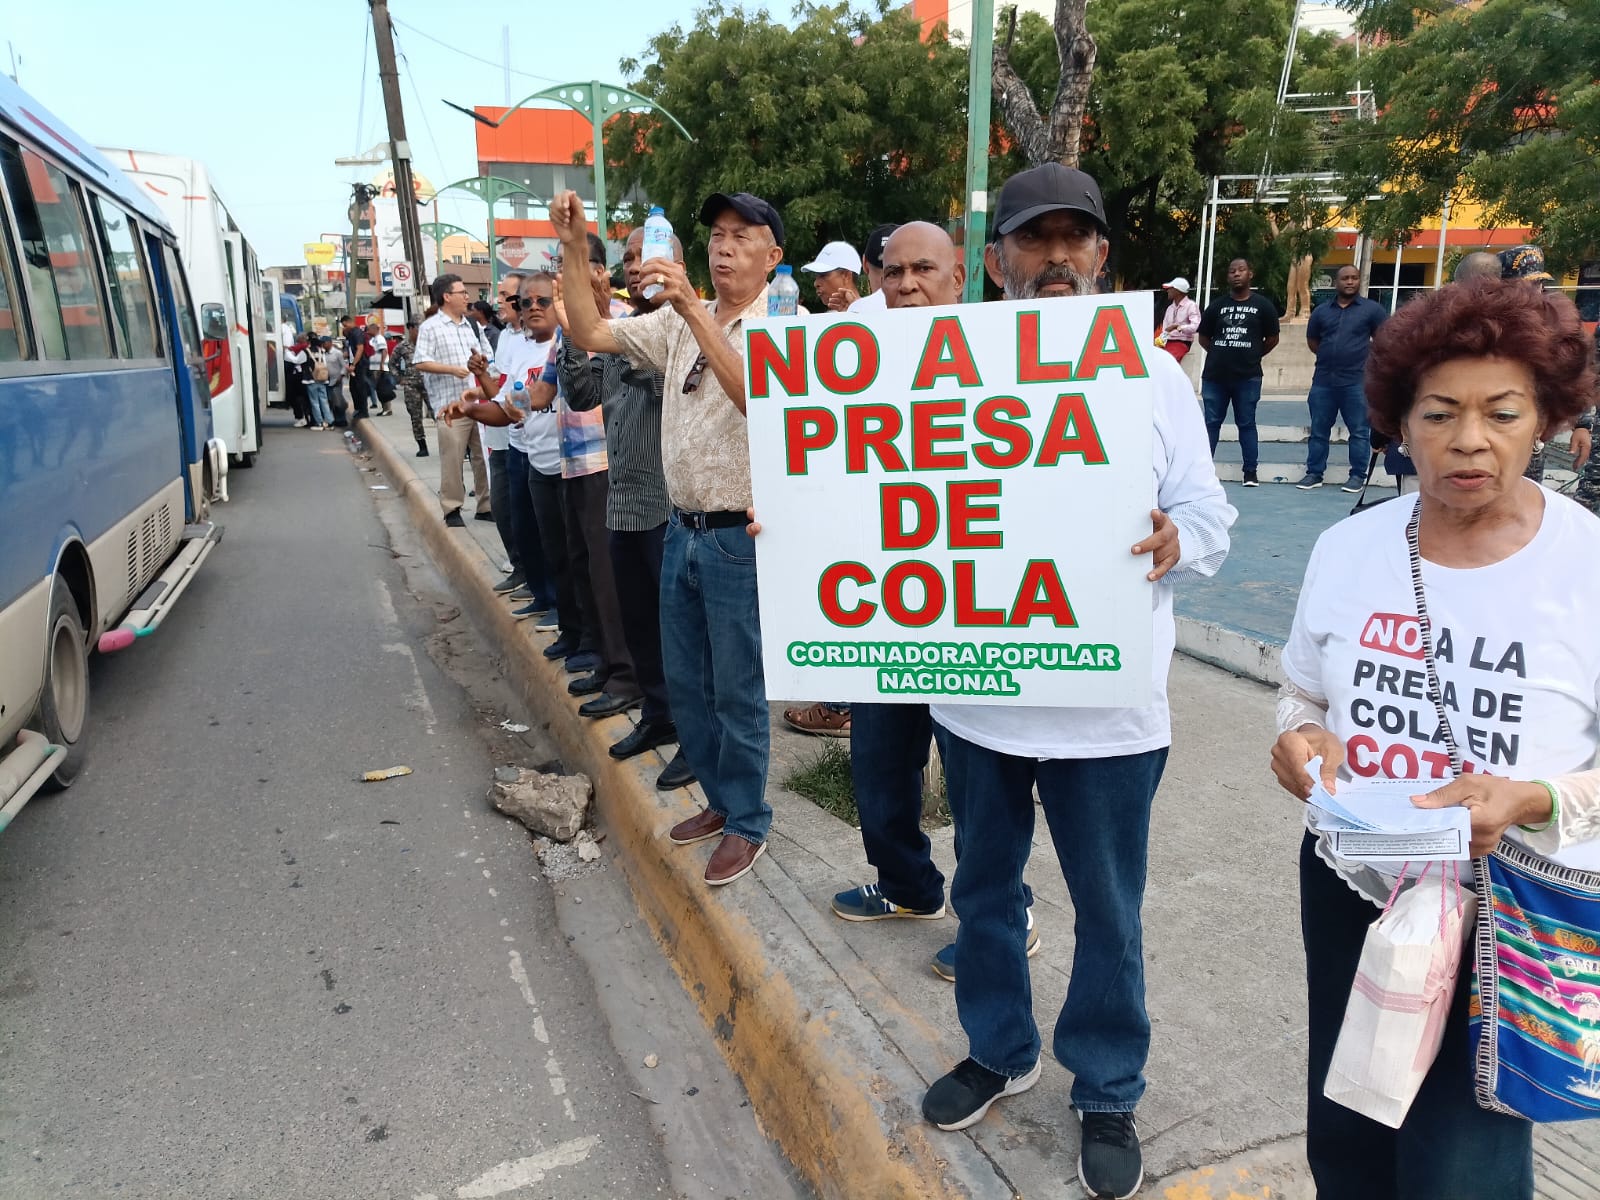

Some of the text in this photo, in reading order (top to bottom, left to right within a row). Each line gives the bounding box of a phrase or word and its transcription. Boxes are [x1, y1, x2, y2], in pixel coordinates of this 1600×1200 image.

[1220, 305, 1258, 315] IT'S WHAT
[1225, 326, 1248, 334] DRINK
[746, 304, 1151, 399] NO A LA
[784, 392, 1110, 476] PRESA
[879, 478, 1004, 552] DE
[818, 558, 1080, 630] COLA
[790, 644, 1117, 668] CORDINADORA POPULAR
[1363, 617, 1526, 679] NO A LA
[881, 670, 1016, 693] NACIONAL
[1472, 687, 1523, 723] DE
[1466, 725, 1519, 766] EN
